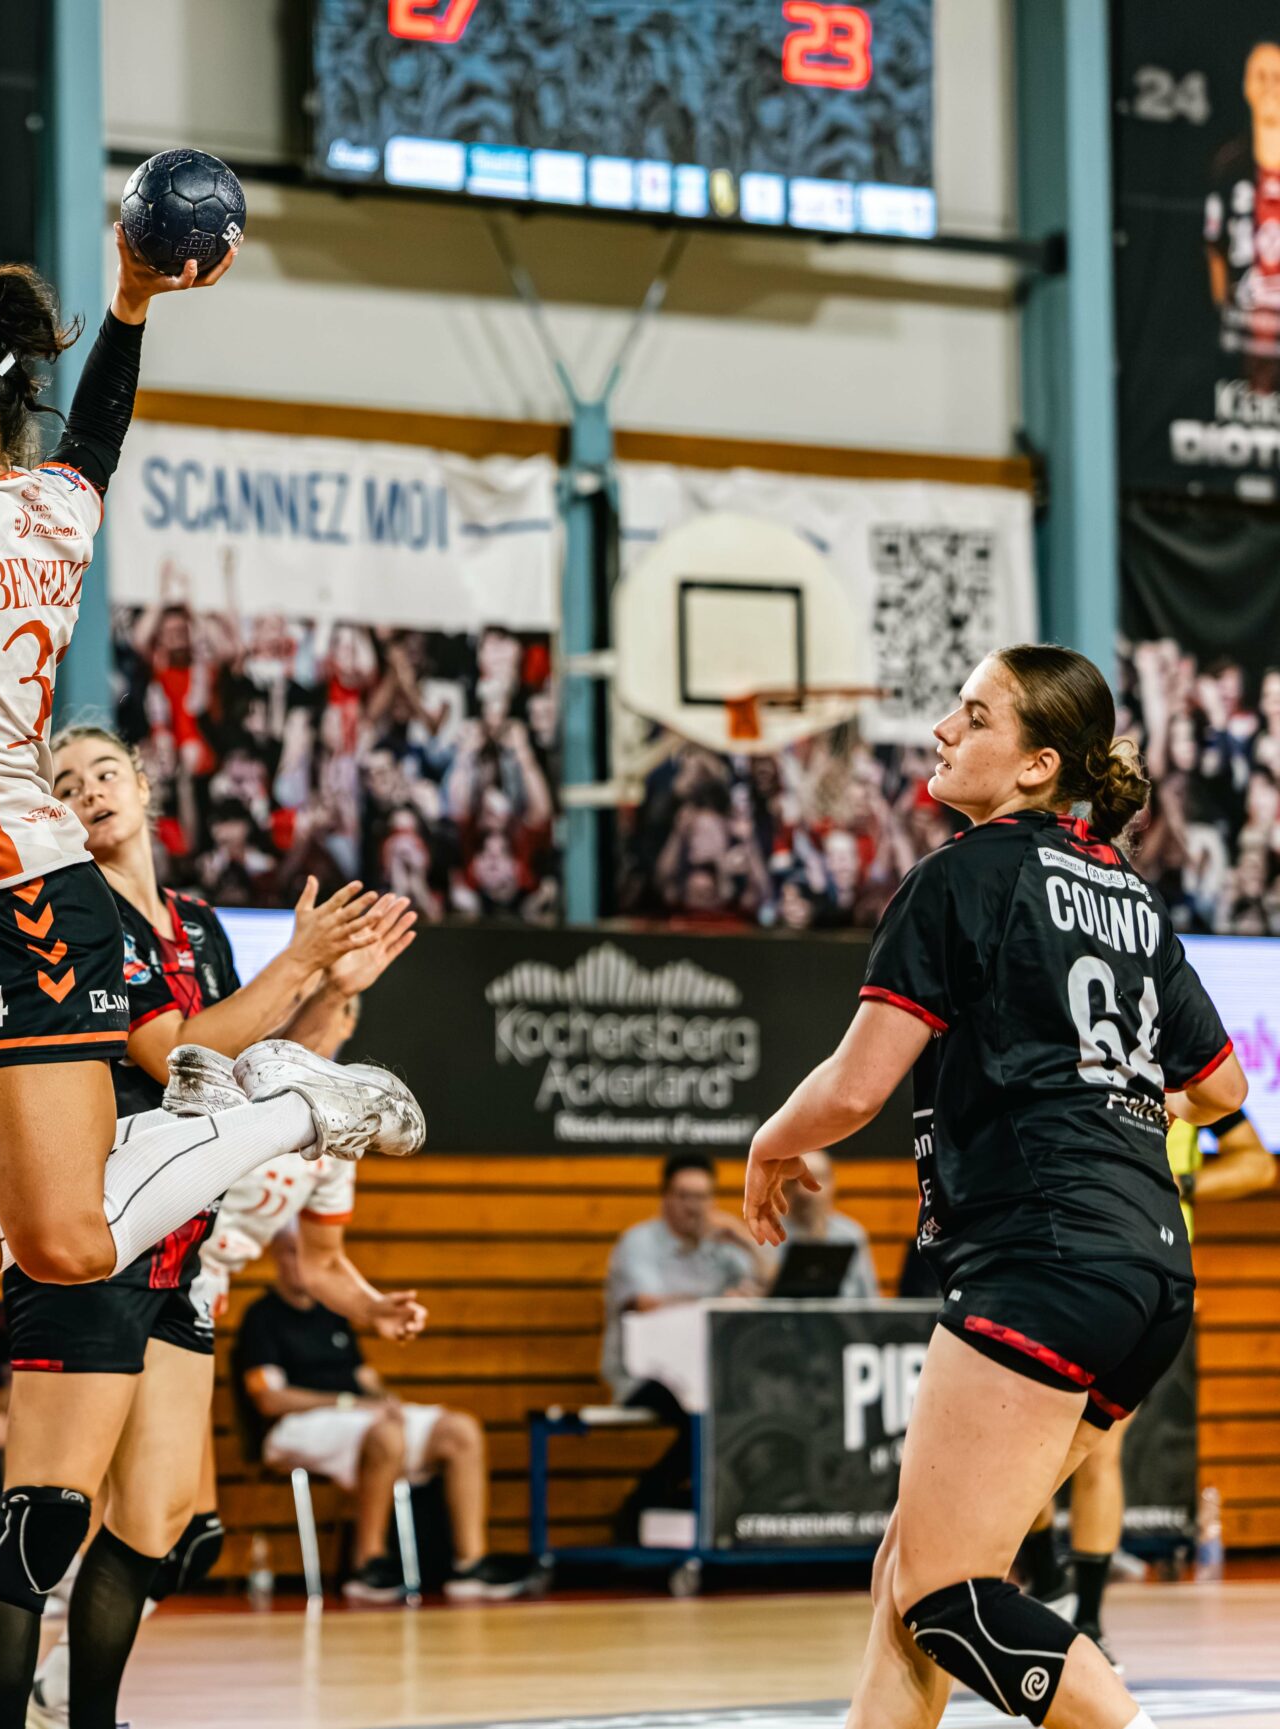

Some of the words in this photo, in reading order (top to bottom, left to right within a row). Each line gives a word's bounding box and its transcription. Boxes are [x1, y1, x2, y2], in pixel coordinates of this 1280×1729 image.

[782, 0, 873, 90] 23
[1133, 66, 1210, 125] 24
[141, 456, 350, 546] SCANNEZ
[364, 474, 449, 552] MOI
